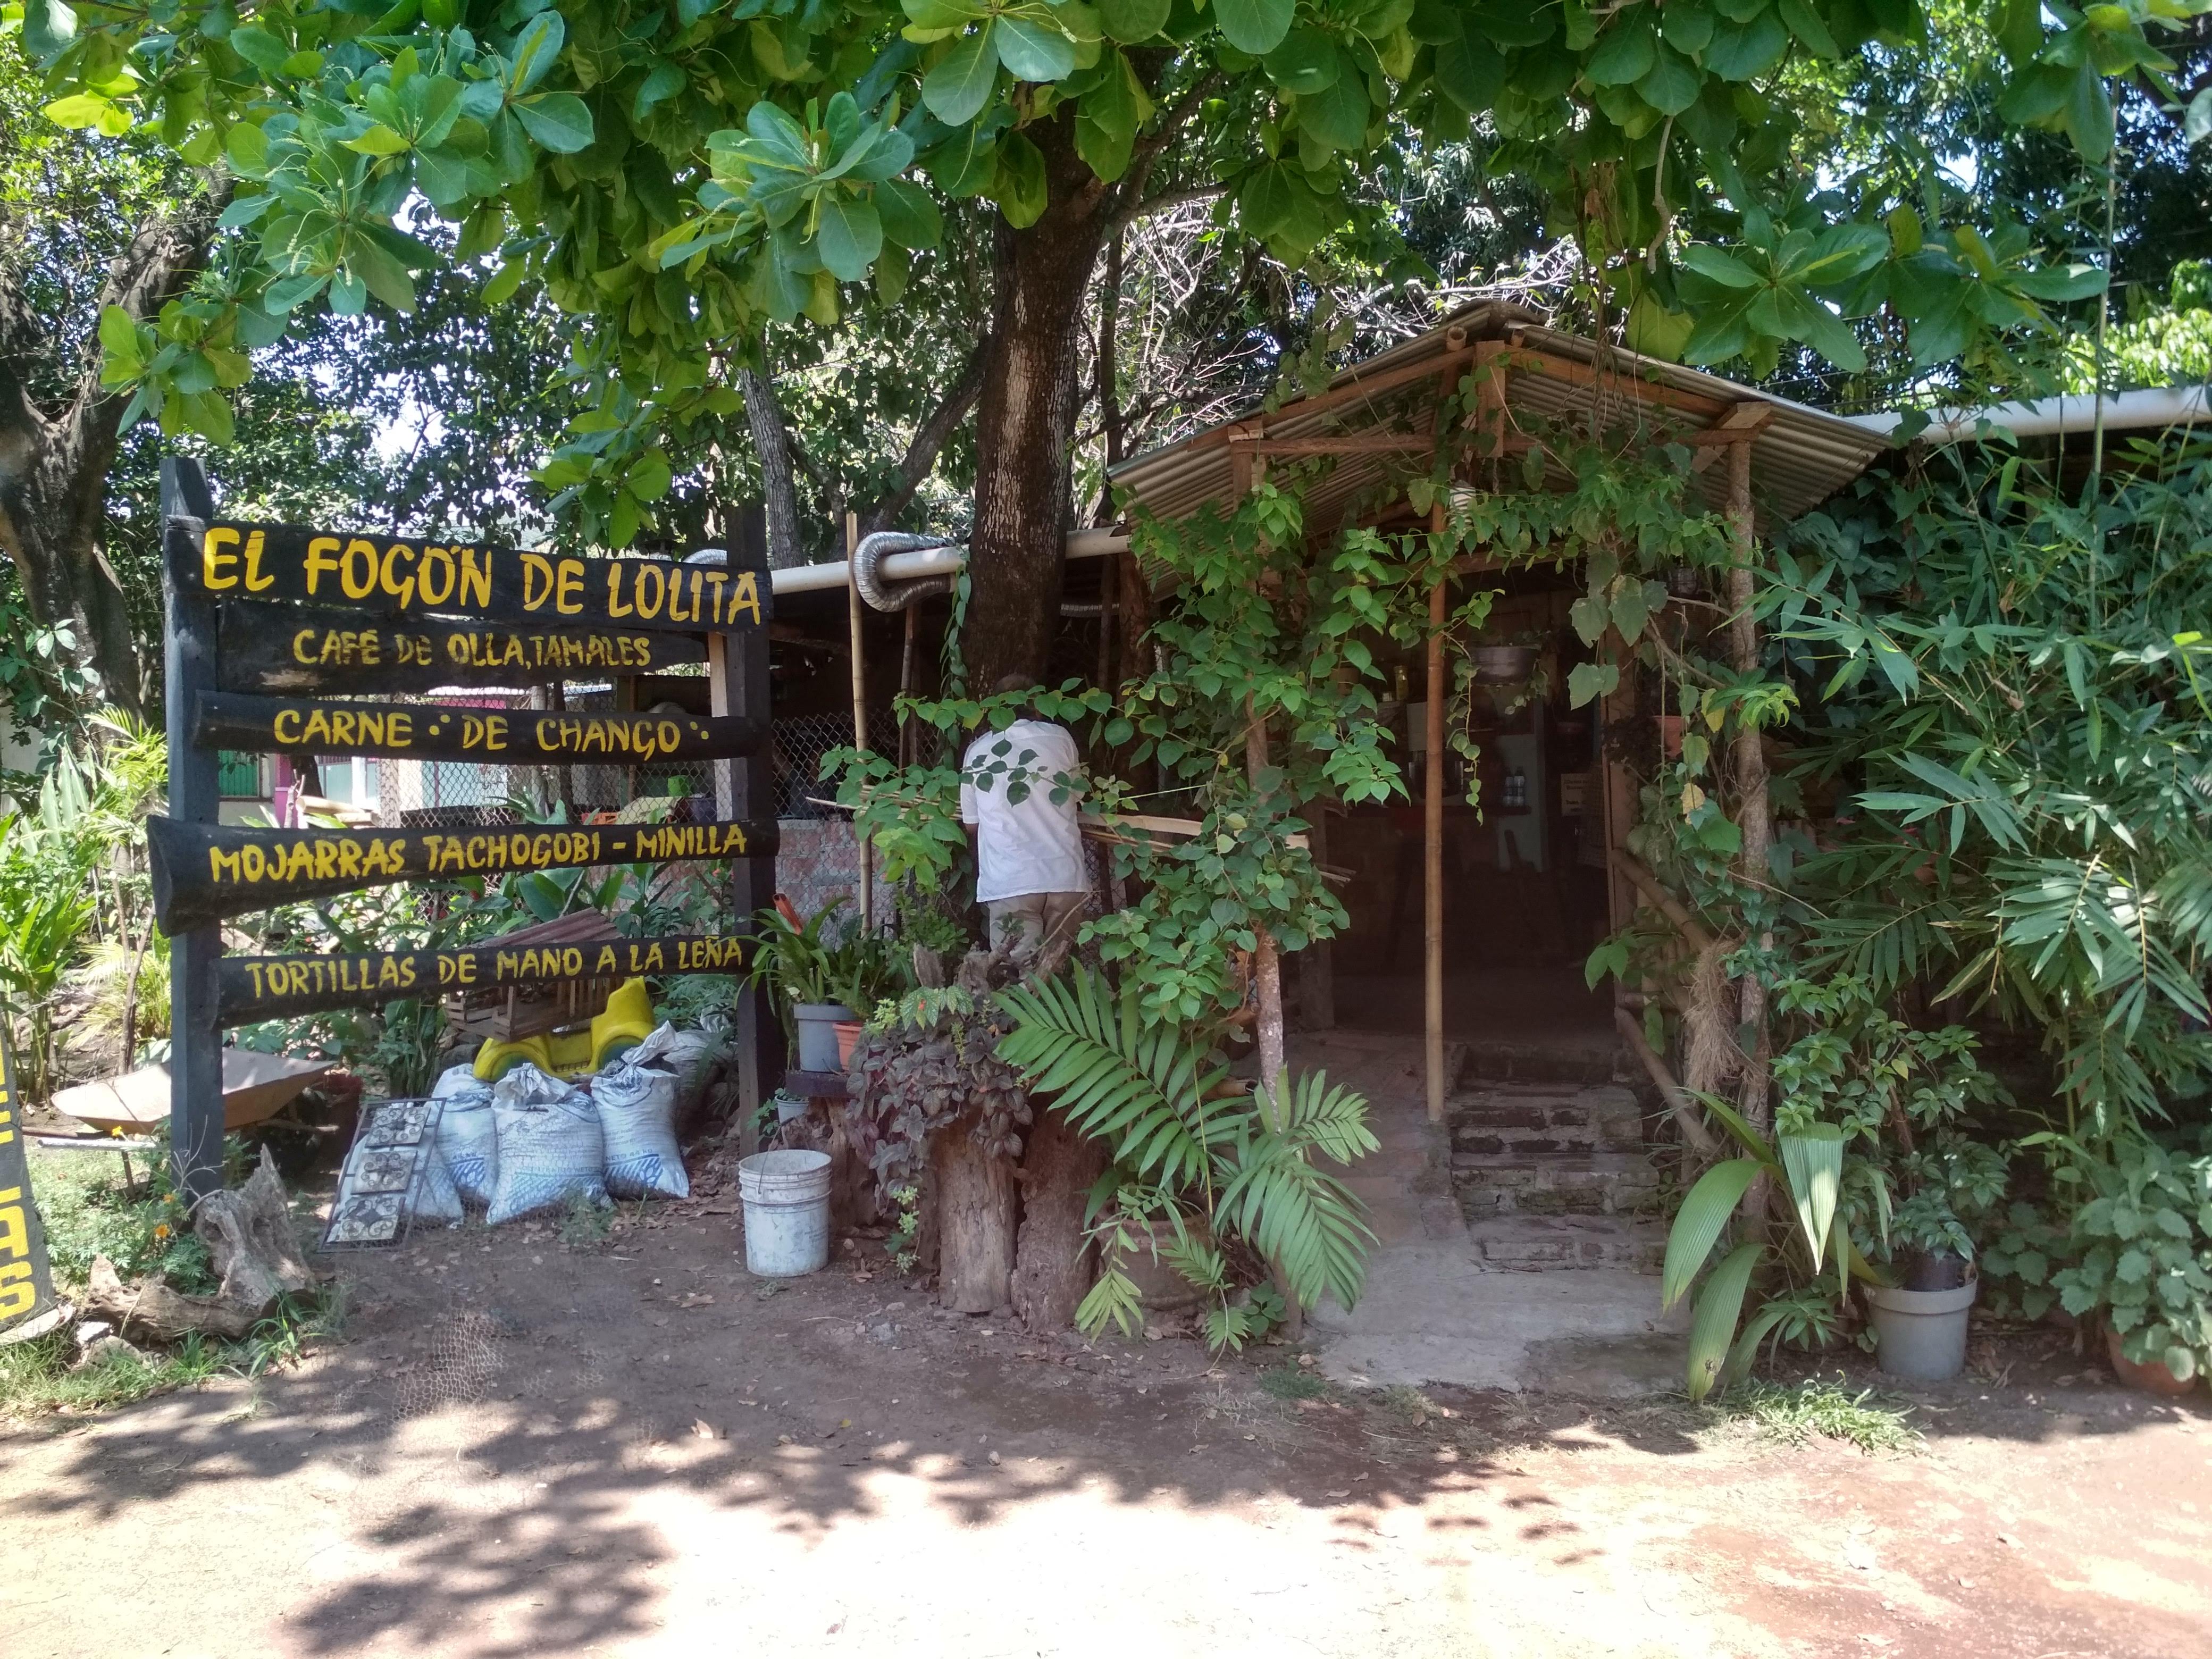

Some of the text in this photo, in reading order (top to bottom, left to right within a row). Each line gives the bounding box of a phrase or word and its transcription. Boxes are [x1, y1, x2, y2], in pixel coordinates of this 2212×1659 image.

[202, 527, 761, 626] EL FOGÓN DE LOLITA
[394, 633, 432, 665] DE
[274, 709, 681, 761] CARNE DE CHANGO
[210, 838, 406, 885] MOJARRAS
[423, 831, 600, 872] TACHOGOBI
[636, 824, 747, 859] MINILLA
[246, 935, 742, 998] TORTILLAS DE MANO A LA LEÑA
